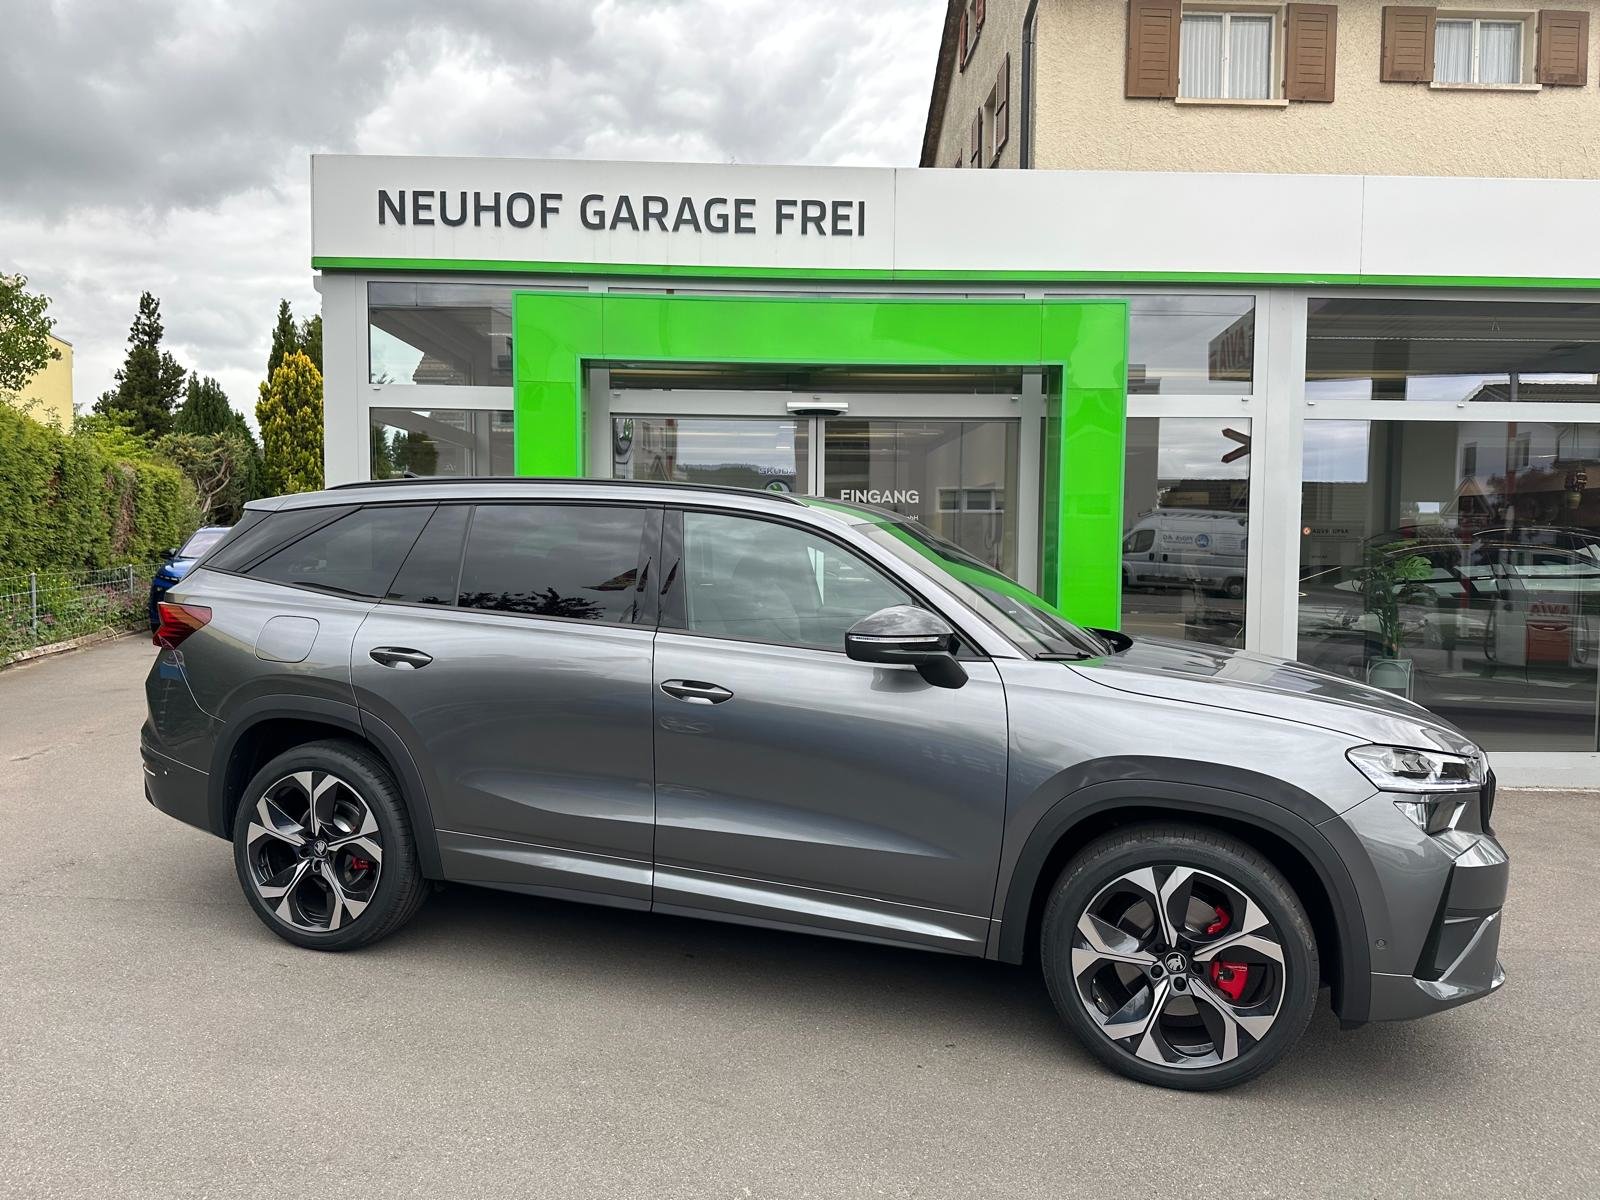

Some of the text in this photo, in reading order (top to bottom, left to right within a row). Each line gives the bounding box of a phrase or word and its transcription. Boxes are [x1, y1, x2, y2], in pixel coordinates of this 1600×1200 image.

[378, 189, 866, 236] NEUHOF GARAGE FREI
